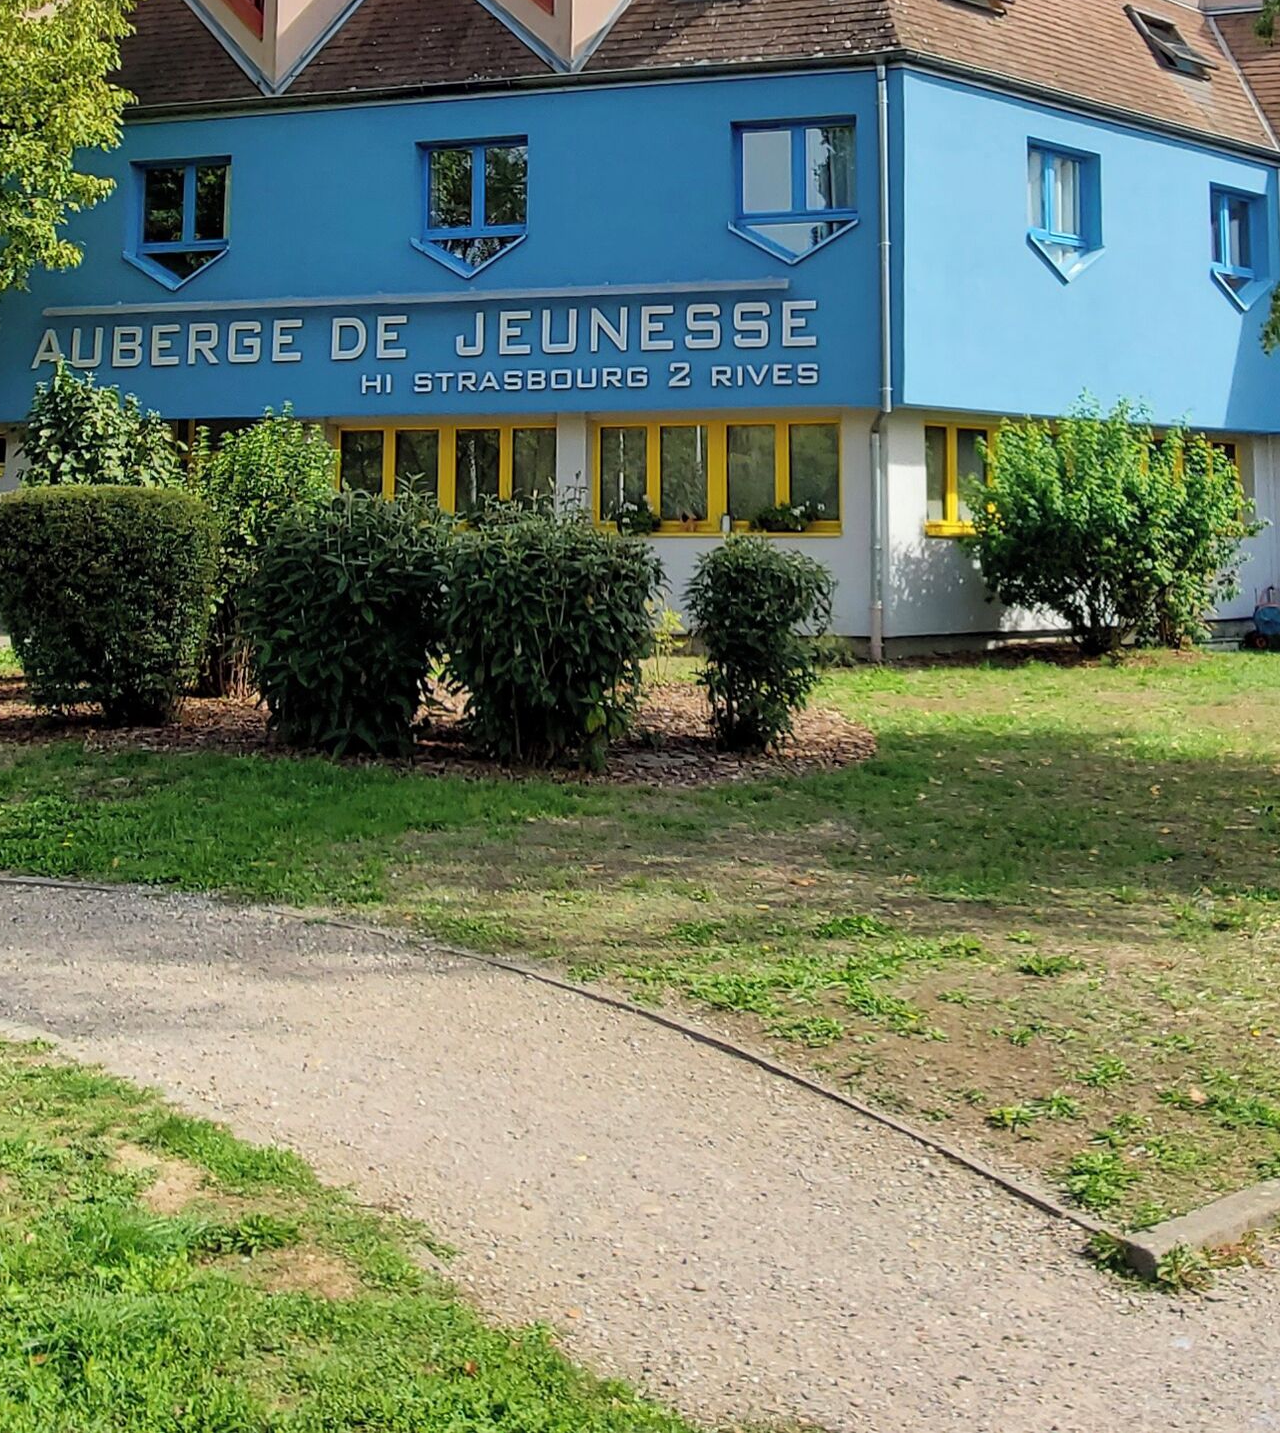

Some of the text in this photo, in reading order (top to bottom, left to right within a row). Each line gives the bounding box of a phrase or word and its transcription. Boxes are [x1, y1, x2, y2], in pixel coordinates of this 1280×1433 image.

[32, 300, 817, 369] AUBERGE DE JEUNESSE
[360, 362, 819, 395] HI STRASBOURG 2 RIVES
